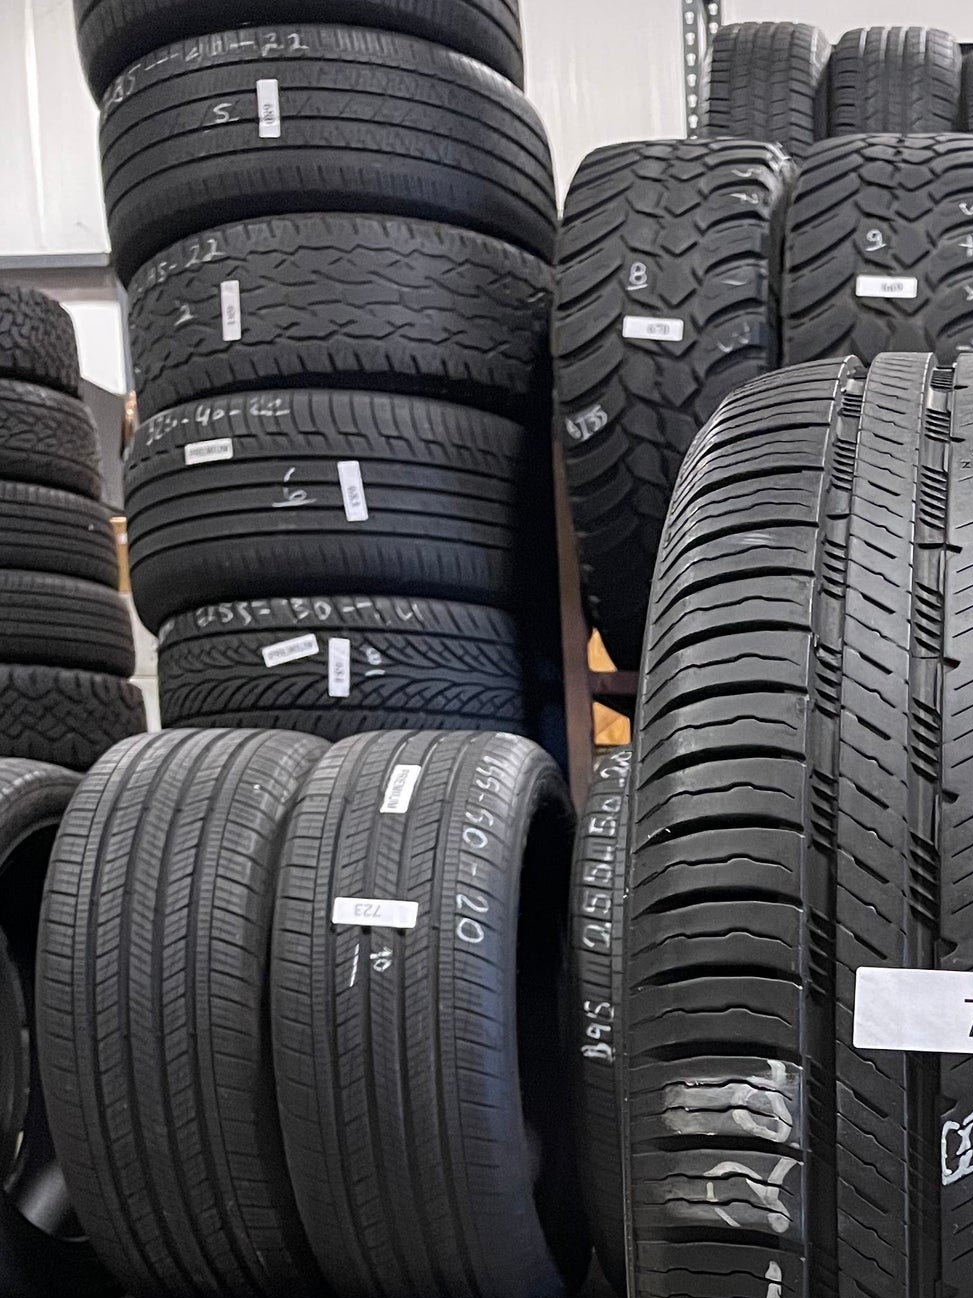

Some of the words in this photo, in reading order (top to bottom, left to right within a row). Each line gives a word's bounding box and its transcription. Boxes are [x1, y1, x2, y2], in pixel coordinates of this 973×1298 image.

[629, 262, 648, 285] 8
[386, 767, 412, 810] PREMIUM
[353, 902, 382, 919] 723
